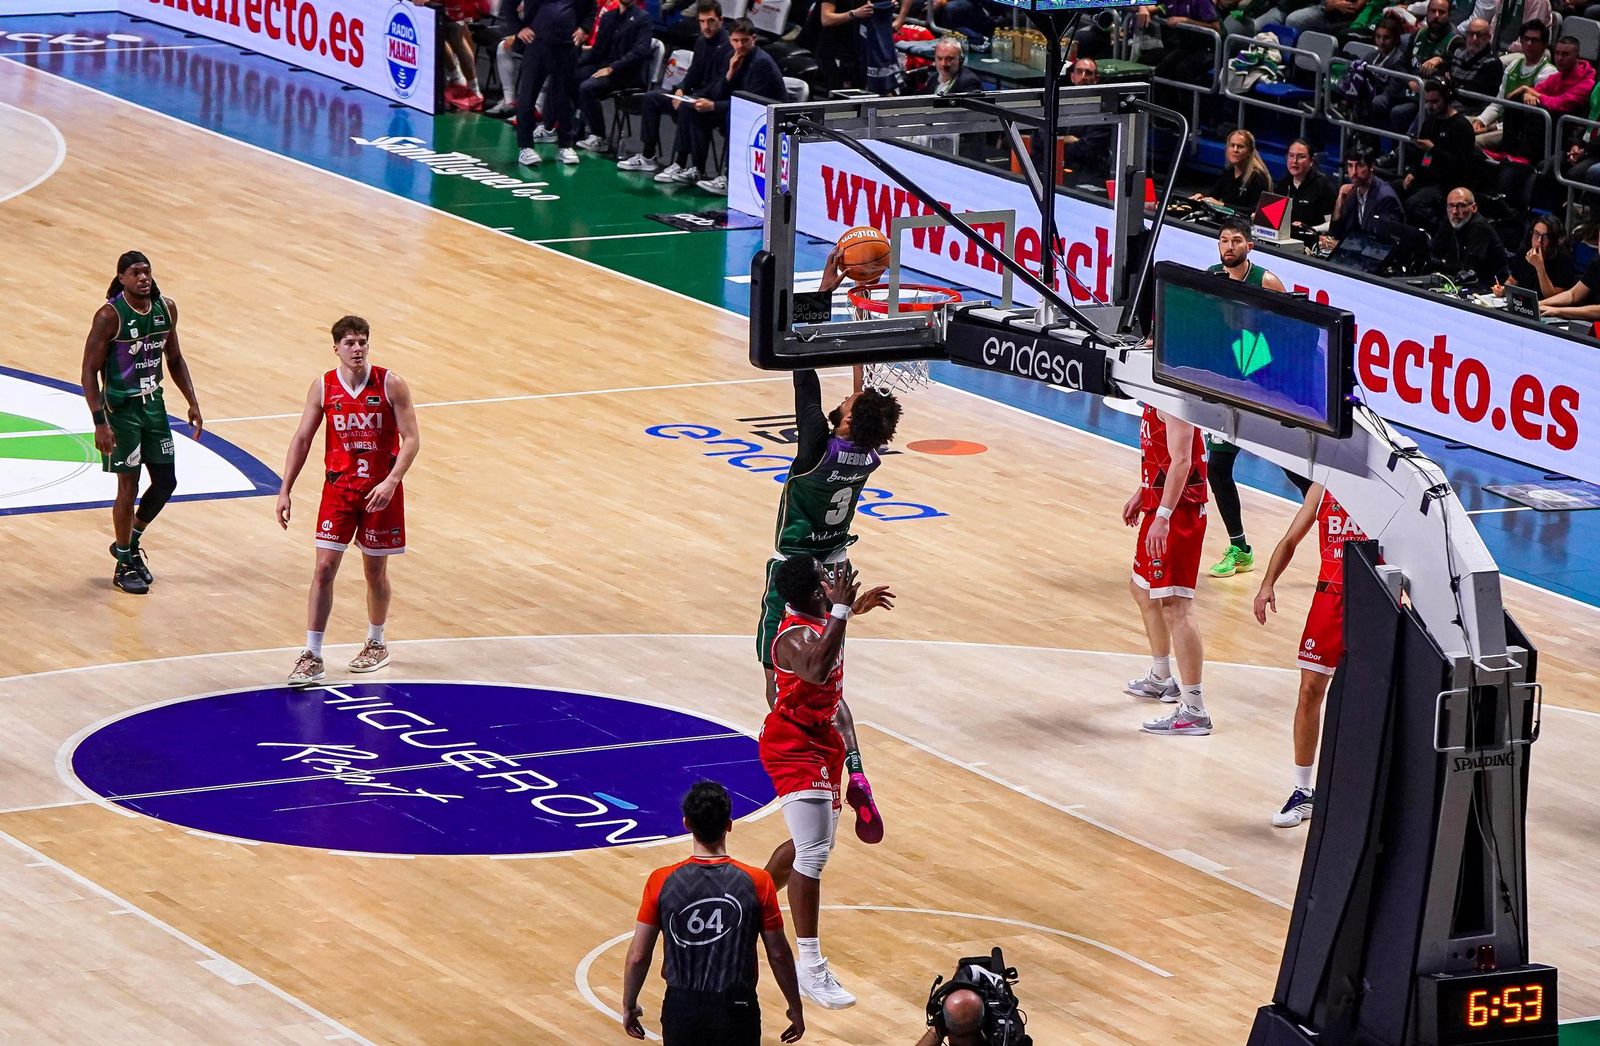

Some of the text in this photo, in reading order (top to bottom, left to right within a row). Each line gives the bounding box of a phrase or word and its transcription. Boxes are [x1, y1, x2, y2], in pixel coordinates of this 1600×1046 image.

[391, 21, 414, 41] RADIO
[389, 38, 417, 66] MARCA
[841, 229, 878, 243] Wilson
[982, 336, 1083, 390] endesa
[333, 412, 383, 431] BAXI
[343, 441, 378, 452] MANRESA
[357, 458, 370, 478] 2
[825, 487, 853, 526] 3
[1328, 515, 1364, 535] BA
[366, 533, 378, 542] ETL
[687, 908, 724, 934] 64
[1469, 986, 1542, 1026] 6:53
